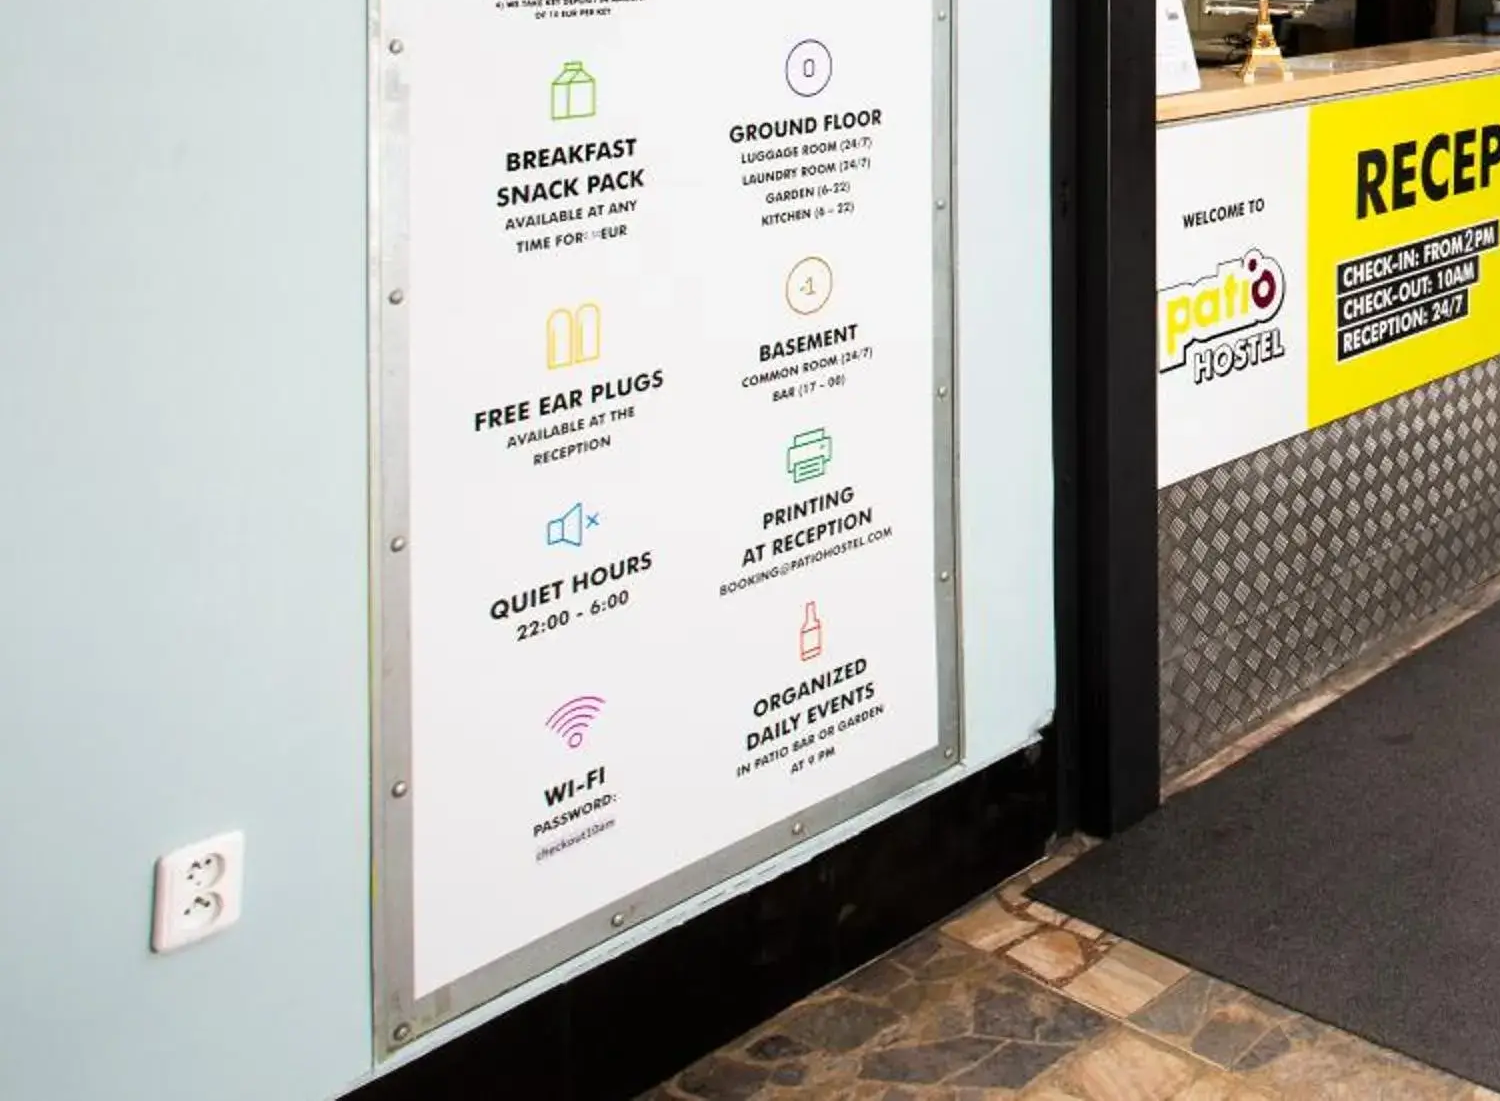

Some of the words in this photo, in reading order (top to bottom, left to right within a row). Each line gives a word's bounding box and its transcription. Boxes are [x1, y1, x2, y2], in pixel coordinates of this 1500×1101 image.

[729, 116, 817, 143] GROUND
[824, 109, 881, 132] FLOOR
[506, 138, 637, 171] BREAKFAST
[741, 146, 799, 164] LUGGAGE
[802, 141, 837, 155] ROOM
[497, 177, 579, 207] SNACK
[587, 169, 644, 194] PACK
[742, 168, 798, 186] LAUNDRY
[802, 162, 836, 177] ROOM
[505, 208, 583, 230] AVAILABLE
[588, 205, 605, 218] AT
[608, 200, 637, 215] ANY
[766, 187, 815, 204] GARDEN
[1183, 202, 1245, 229] WELCOME
[1248, 198, 1264, 214] TO
[516, 236, 550, 253] TIME
[556, 232, 583, 247] FOR
[601, 224, 627, 239] EUR
[761, 209, 811, 227] KITCHEN
[1342, 248, 1420, 288] CHECK-IN:
[1423, 235, 1463, 264] FROM
[1166, 258, 1277, 356] patio
[1343, 276, 1433, 320] CHECK-OUT:
[1436, 262, 1475, 290] 10AM
[759, 324, 858, 362] BASEMENT
[1343, 305, 1429, 354] RECEPTION:
[1432, 294, 1465, 319] 24/7
[742, 365, 799, 388] COMMON
[803, 355, 838, 372] ROOM
[1194, 327, 1285, 385] HOSTEL
[474, 400, 530, 431] FREE
[539, 389, 583, 416] EAR
[591, 369, 664, 403] PLUGS
[772, 387, 795, 402] BAR
[507, 418, 584, 449] AVAILABLE
[589, 413, 606, 428] AT
[610, 406, 635, 422] THE
[533, 434, 611, 466] RECEPTION
[763, 486, 855, 529] PRINTING
[742, 544, 766, 567] AT
[772, 507, 873, 556] RECEPTION
[719, 526, 893, 597] BOOKING@PATIOHOSTEL.COM
[490, 579, 564, 620] QUIET
[572, 551, 652, 593] HOURS
[517, 610, 570, 642] 22:00
[590, 589, 629, 615] 6:00
[753, 658, 867, 717] ORGANIZED
[746, 712, 801, 751] DAILY
[807, 682, 875, 724] EVENTS
[737, 763, 751, 778] IN
[754, 747, 788, 769] PATIO
[792, 734, 815, 752] BAR
[818, 726, 835, 740] OR
[838, 703, 884, 732] GARDEN
[790, 760, 804, 775] AT
[818, 747, 836, 761] PM
[544, 766, 605, 807] WI-FI
[533, 794, 617, 838] PASSWORD:
